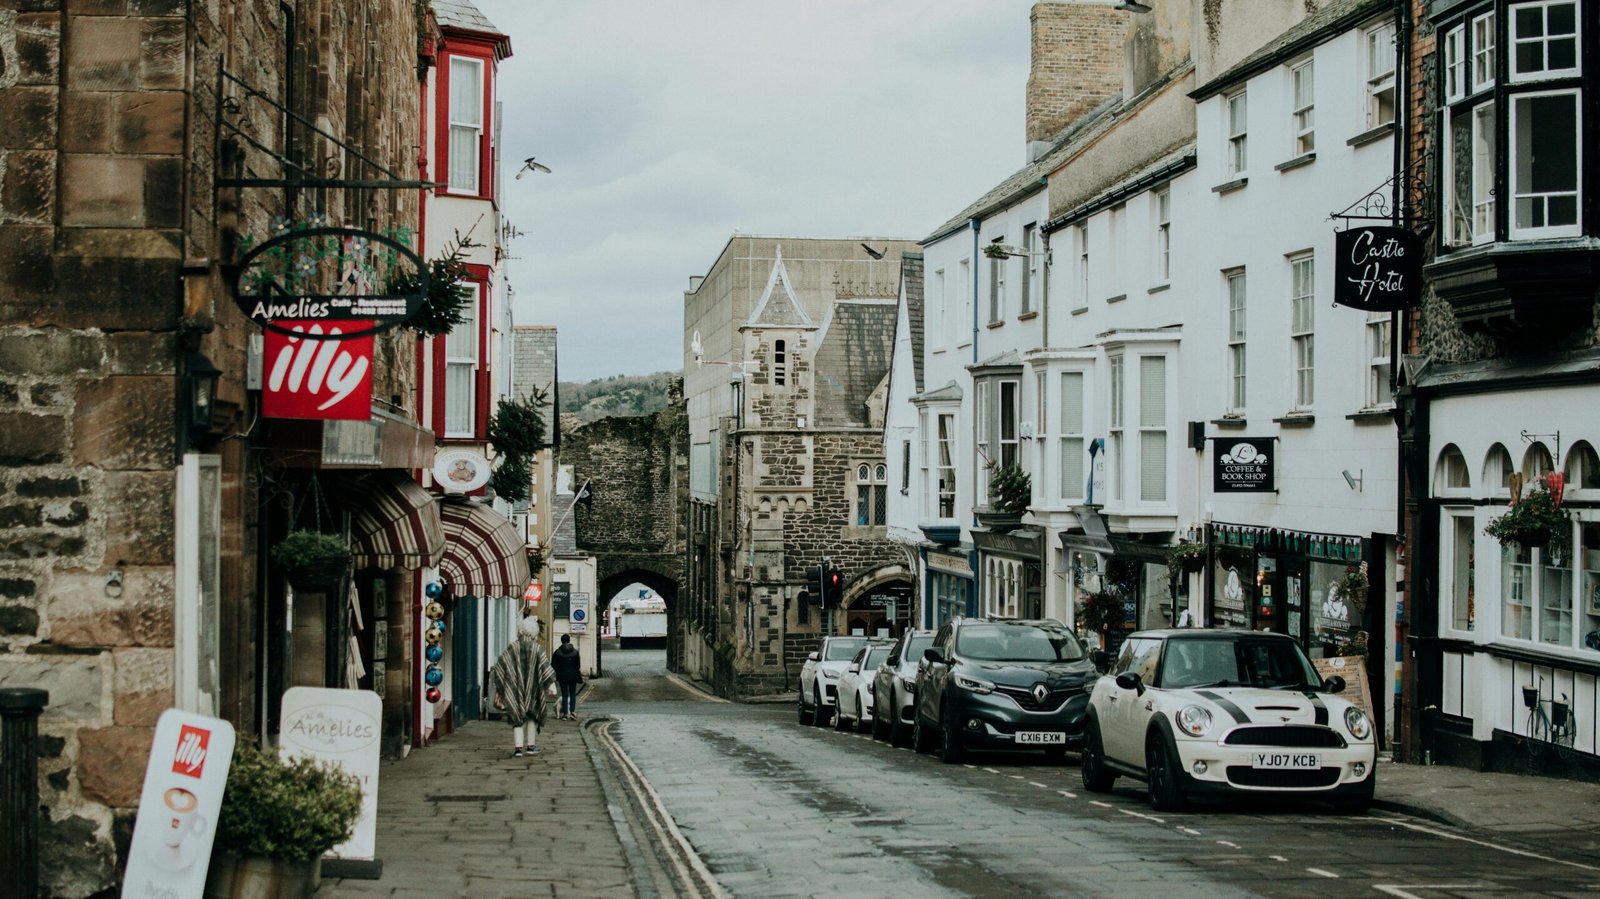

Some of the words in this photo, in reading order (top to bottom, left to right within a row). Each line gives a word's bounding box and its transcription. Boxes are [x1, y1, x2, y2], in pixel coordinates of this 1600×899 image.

[1352, 230, 1405, 265] Castle
[1348, 262, 1404, 302] Hotel
[251, 297, 330, 319] Amelies
[358, 298, 407, 307] Restaurant
[268, 323, 369, 411] illy
[1221, 472, 1244, 480] BOOK
[1244, 472, 1267, 480] SHOP
[1225, 465, 1255, 473] COFFEE
[1255, 465, 1262, 473] &
[288, 719, 373, 738] Amelies
[1020, 732, 1041, 742] CX16
[1043, 733, 1061, 743] EXM
[175, 732, 206, 773] illy
[1258, 754, 1290, 766] YJ07
[1293, 754, 1316, 767] KCB
